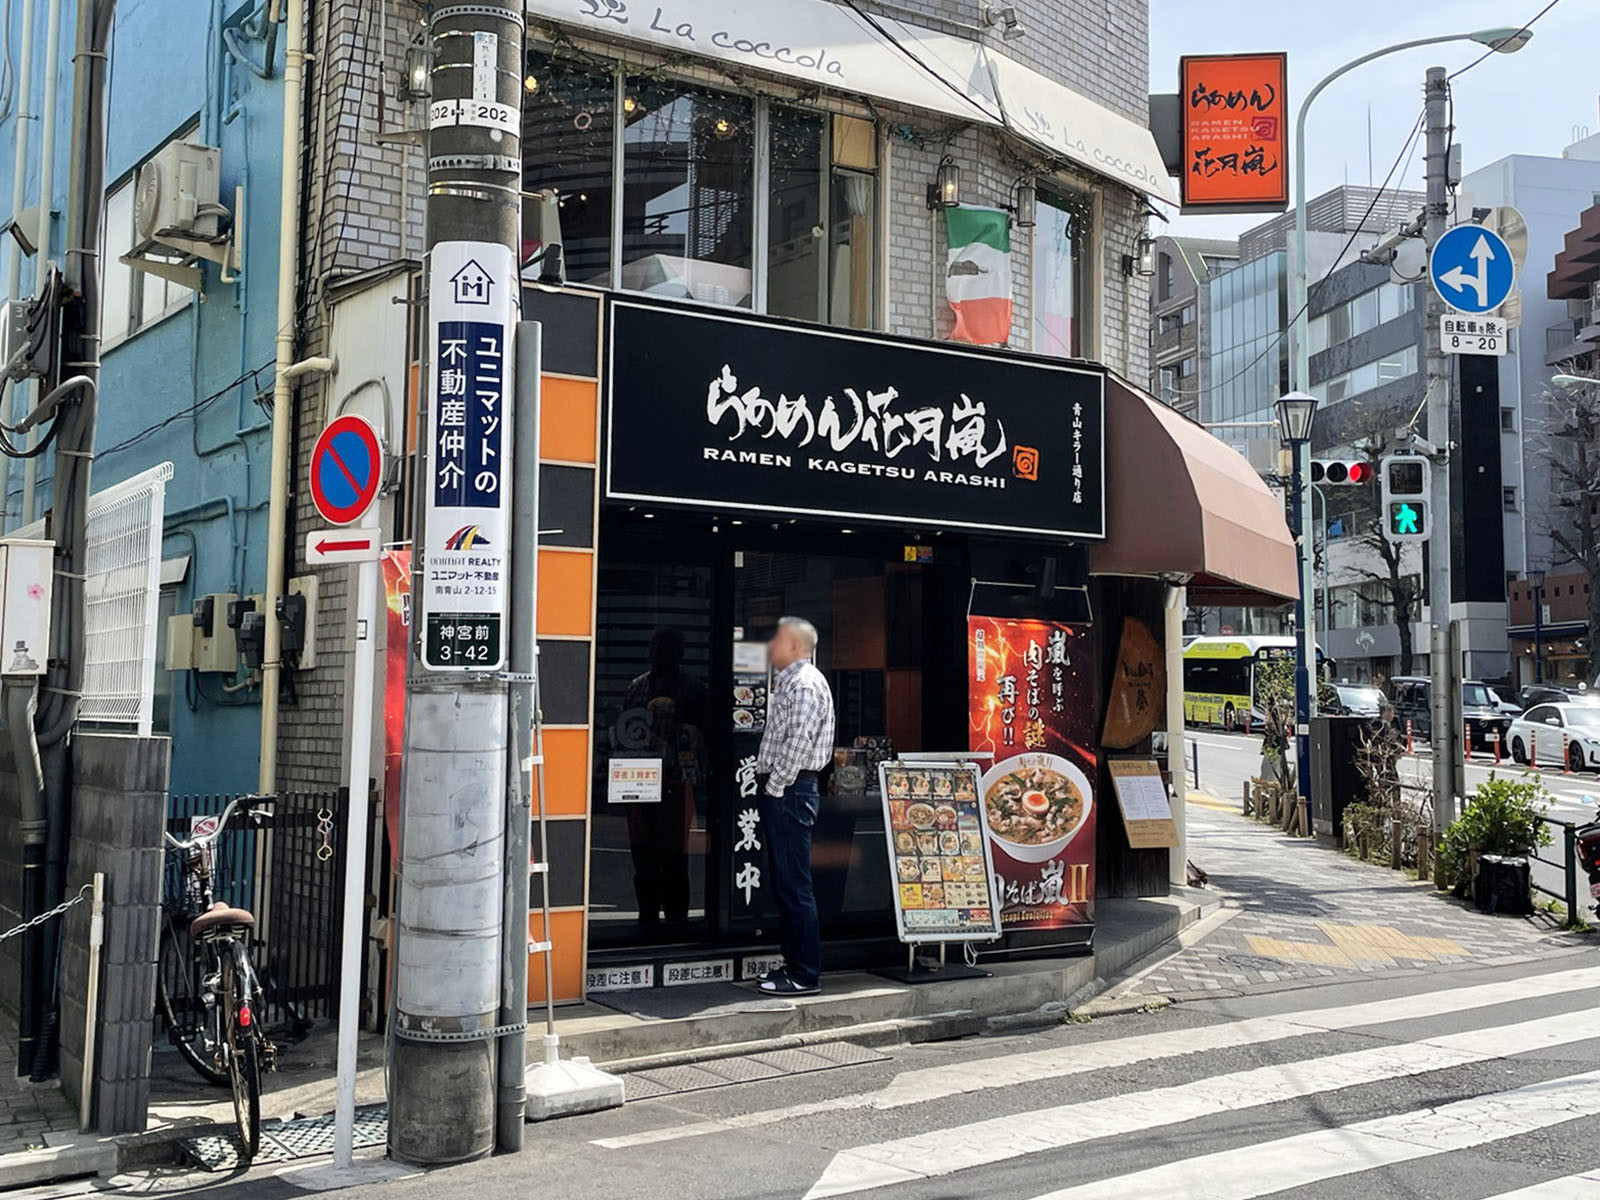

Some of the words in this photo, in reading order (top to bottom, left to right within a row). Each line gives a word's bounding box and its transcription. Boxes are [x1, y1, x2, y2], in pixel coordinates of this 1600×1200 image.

[650, 7, 696, 41] La
[711, 32, 845, 78] coccola
[478, 106, 508, 123] 202
[1191, 119, 1243, 127] RAMEN
[1191, 126, 1260, 134] KAGETSU
[1063, 126, 1088, 156] La
[1093, 148, 1161, 190] coccola
[1192, 144, 1278, 178] 花月嵐
[1445, 320, 1503, 335] 自転車を除く
[438, 338, 467, 490] 不動産仲介
[475, 337, 501, 494] ユニマットの
[703, 447, 792, 468] RAMEN
[807, 457, 916, 480] KAGETSU
[923, 469, 1006, 489] ARASHI
[1072, 402, 1083, 504] 青山キラー通り店
[431, 570, 499, 581] ユニマット不動産
[468, 557, 501, 566] REALTY
[440, 625, 490, 641] 神宮前
[440, 645, 489, 660] 3-42
[1045, 630, 1071, 713] 嵐を呼ぶ
[735, 754, 762, 907] 営業中
[996, 860, 1069, 907] そば嵐
